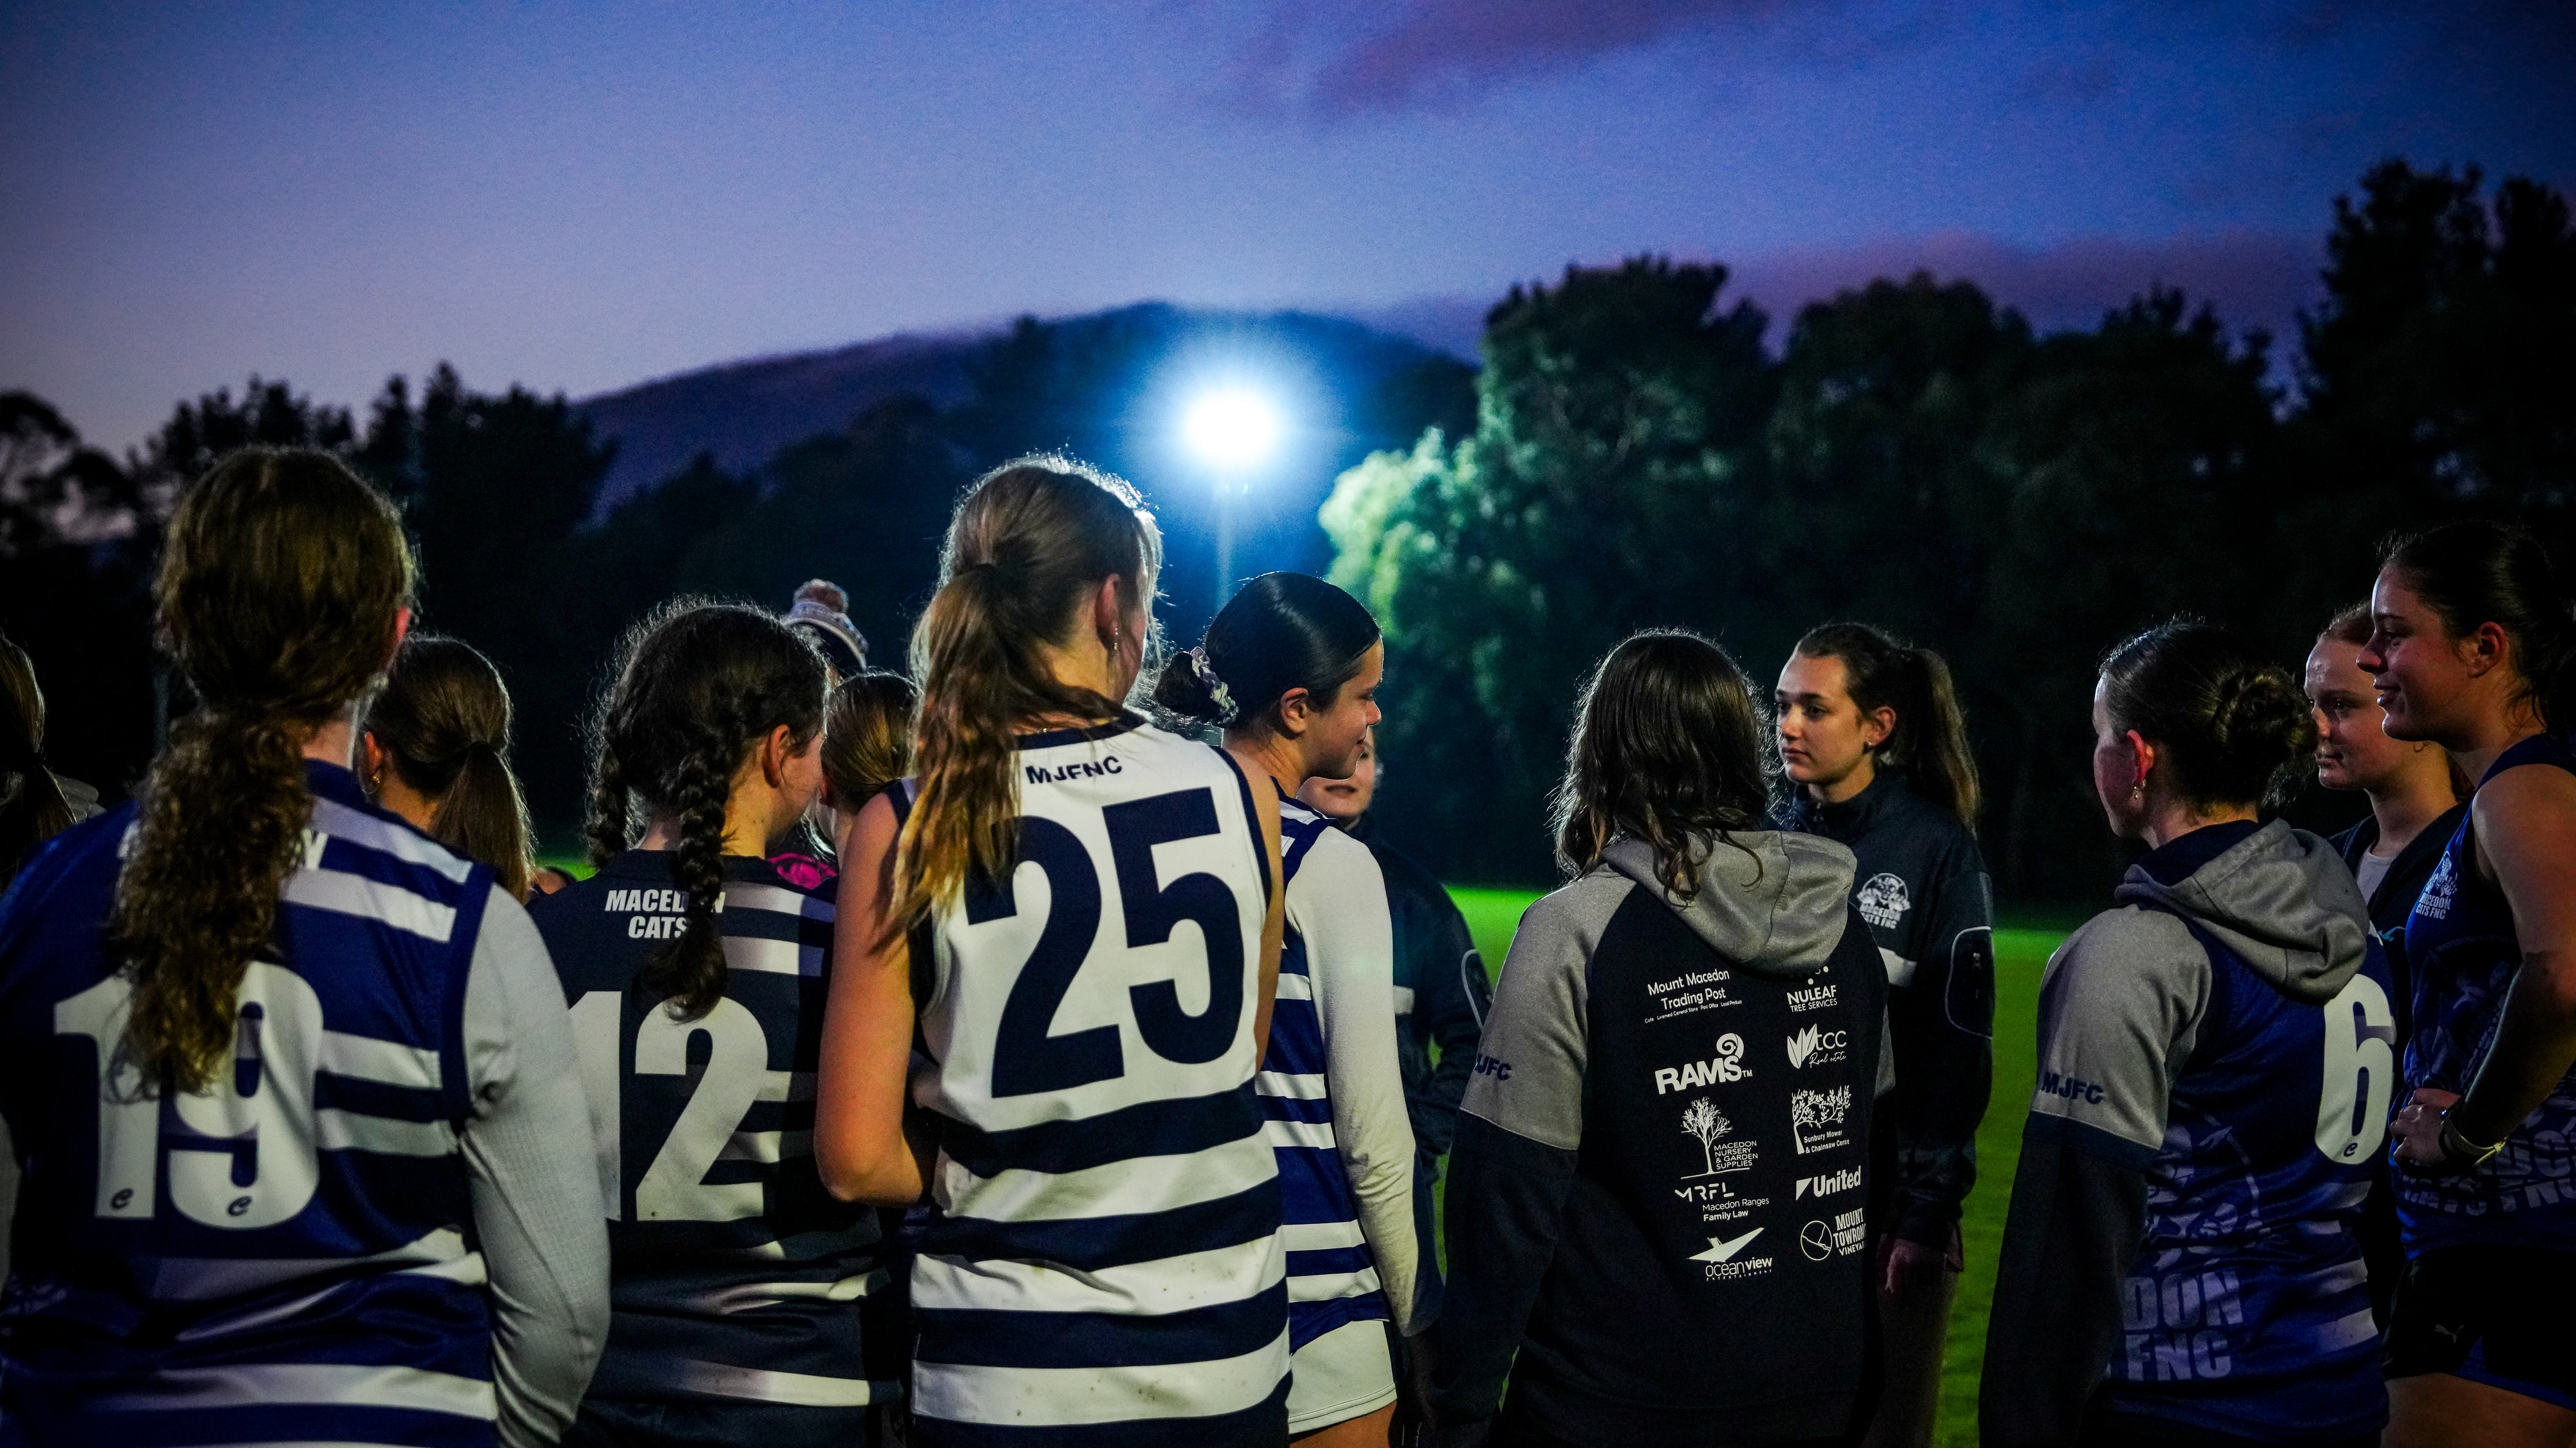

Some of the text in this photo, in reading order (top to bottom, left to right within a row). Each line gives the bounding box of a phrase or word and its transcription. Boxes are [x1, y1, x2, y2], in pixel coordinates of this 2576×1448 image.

[1025, 756, 1122, 784] MJFNC
[605, 889, 726, 914] MACEDN
[628, 916, 691, 939] CATS
[964, 787, 1244, 1098] 25
[1647, 968, 1730, 995] Mount Macedon
[1661, 987, 1726, 1010] Trading Post
[1786, 985, 1837, 1005] NULEAF
[1790, 999, 1837, 1012] TREE SERVICES
[1654, 1055, 1742, 1095] RAMS
[2315, 973, 2394, 1164] 6
[53, 959, 324, 1231] 19
[2041, 1072, 2103, 1104] MJFC
[567, 991, 768, 1221] 12
[1714, 1140, 1757, 1151] MACEDON
[1804, 1134, 1826, 1143] Sunbury
[1812, 1142, 1835, 1152] Chainsaw
[1715, 1147, 1752, 1157] NURSERY
[1723, 1153, 1758, 1161] GARDEN
[1716, 1160, 1752, 1170] SUPPLIES
[1674, 1181, 1734, 1202] MRFL
[1814, 1165, 1861, 1197] United
[1703, 1198, 1770, 1211] Macedon Ranges
[1703, 1212, 1731, 1221] Family
[1835, 1207, 1864, 1231] MOUNT
[1839, 1241, 1866, 1256] VINEYAR
[2125, 1330, 2231, 1382] FNC
